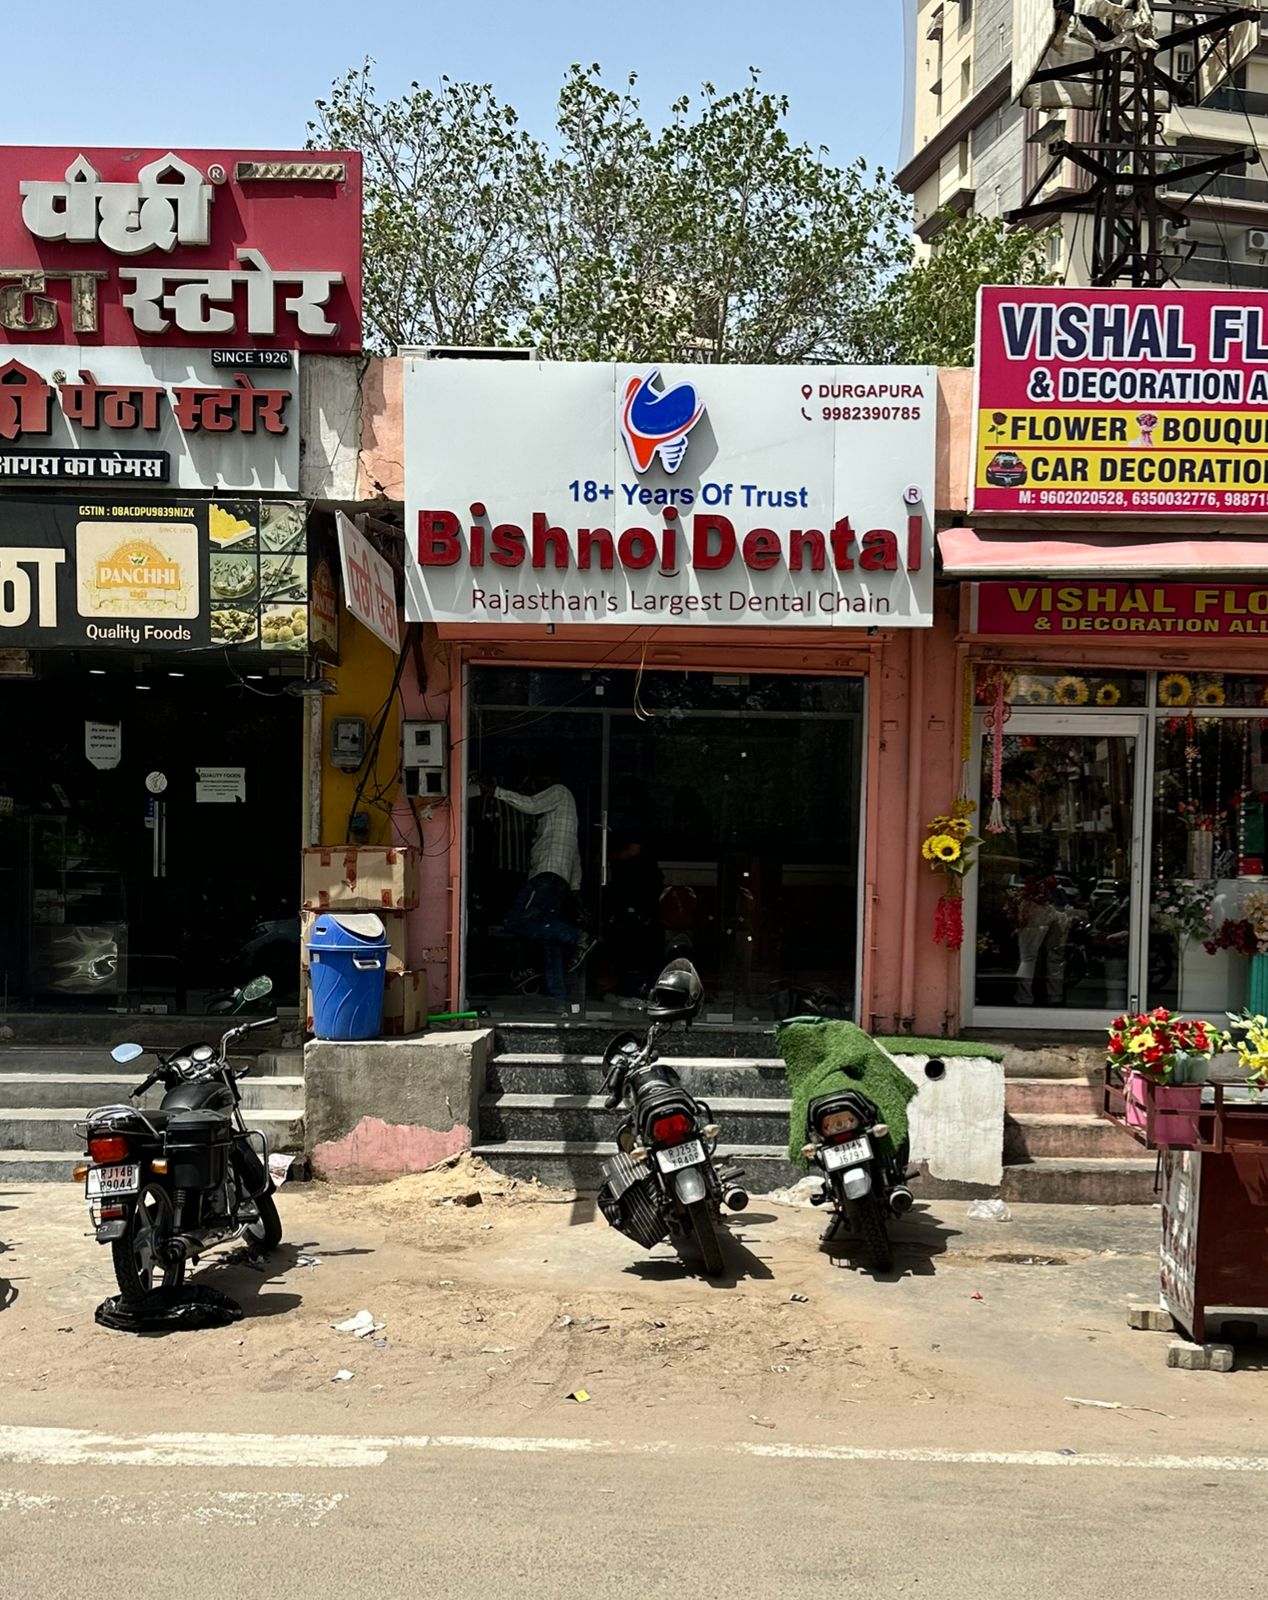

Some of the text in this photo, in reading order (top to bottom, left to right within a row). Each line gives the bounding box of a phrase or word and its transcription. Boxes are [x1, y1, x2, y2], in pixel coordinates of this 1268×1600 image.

[20, 152, 215, 256] पंछी
[118, 248, 344, 337] स्टोर
[1001, 303, 1194, 361] VISHAL
[213, 351, 288, 364] SINCE 1926
[819, 384, 924, 398] DURGAPURA
[1031, 370, 1051, 399] &
[1063, 371, 1241, 400] DECORATION
[58, 369, 166, 430] पेठा
[172, 372, 292, 433] स्टोर
[822, 406, 921, 420] 9982390785
[1010, 415, 1268, 446] FLOWER BOUQU
[63, 457, 97, 475] का
[99, 452, 163, 477] फेमस
[1031, 457, 1088, 482] CAR
[568, 479, 808, 508] 18+ Years Of Trust
[1019, 491, 1035, 504] M:
[1040, 491, 1128, 507] 9602020528,
[1132, 492, 1220, 508] 6350032776,
[79, 505, 105, 516] GSTIN
[418, 502, 923, 572] Bishnoi Dental
[100, 566, 176, 585] PANCHHI
[472, 588, 890, 615] Rajasthan's Largest Dental Chain
[1007, 587, 1176, 614] VISHAL
[86, 624, 191, 643] Quality Foods
[1034, 617, 1051, 631] &
[1061, 616, 1219, 633] DECORATION
